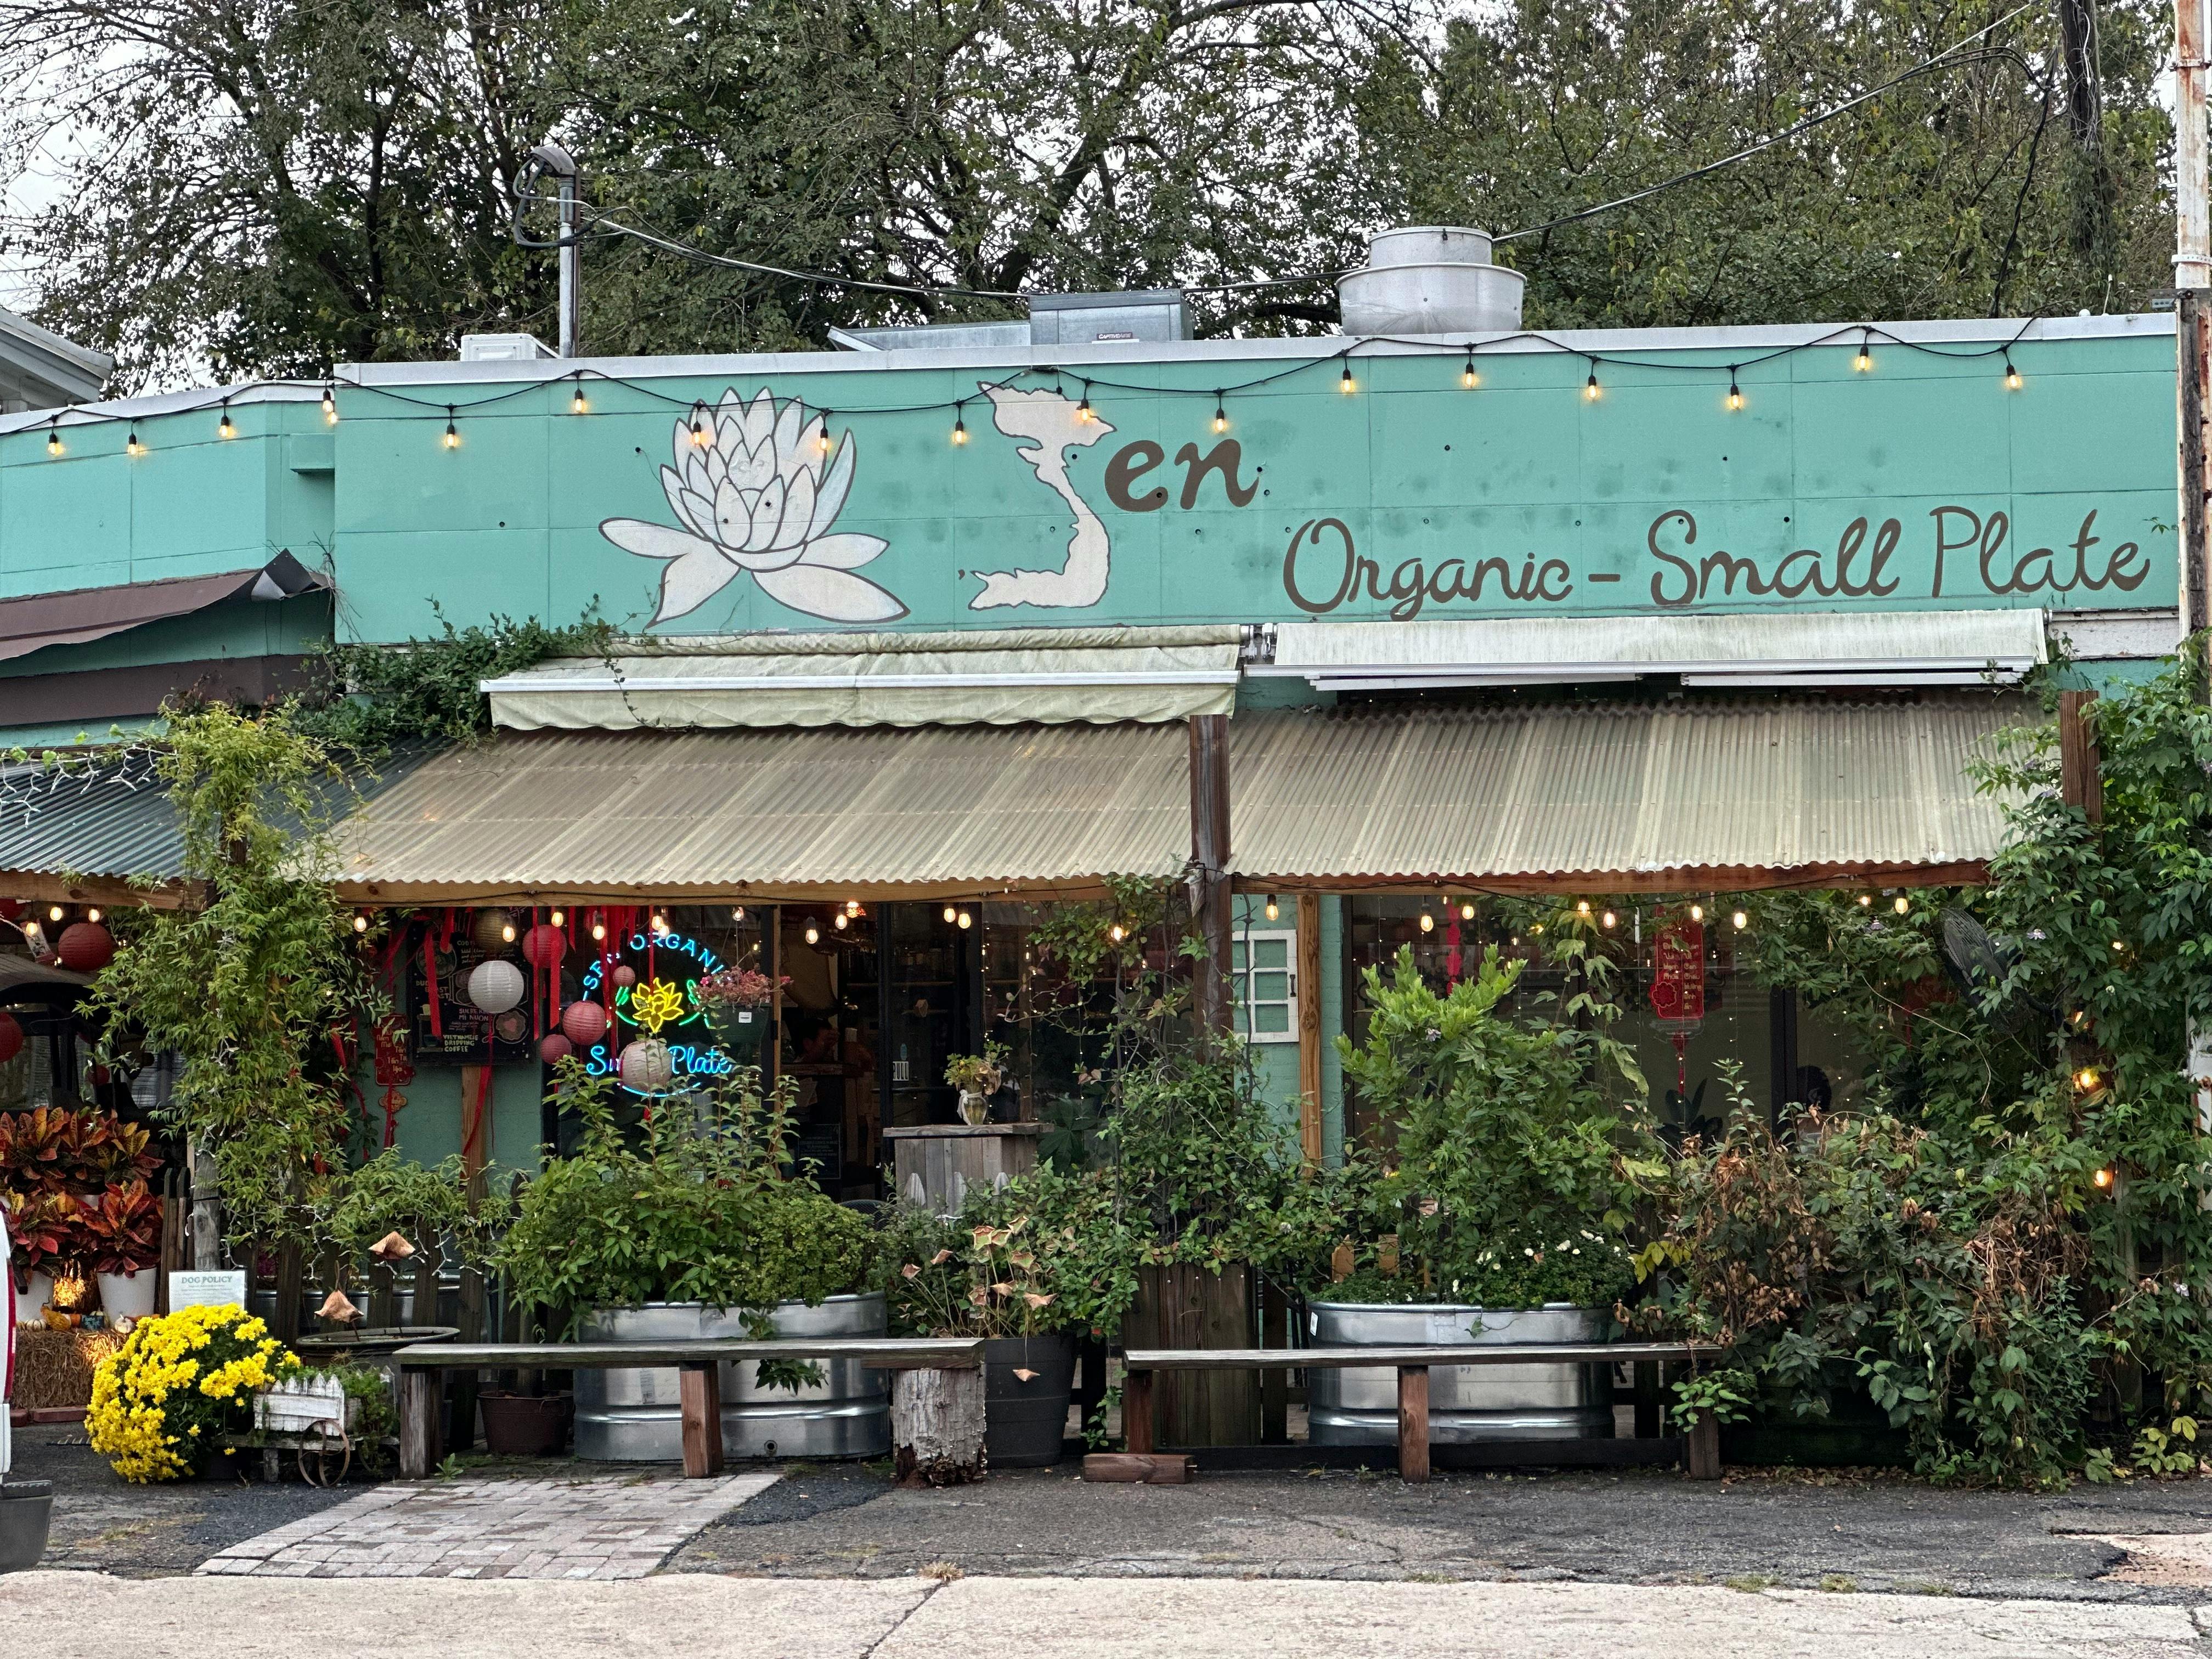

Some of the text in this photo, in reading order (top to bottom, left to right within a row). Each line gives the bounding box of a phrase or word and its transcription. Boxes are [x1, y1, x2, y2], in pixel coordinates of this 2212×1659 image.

[1283, 517, 1573, 622] Organic
[1647, 509, 1901, 605] Small
[1929, 505, 2151, 598] Plate
[667, 1046, 732, 1075] Plate
[202, 1276, 233, 1284] POLICY
